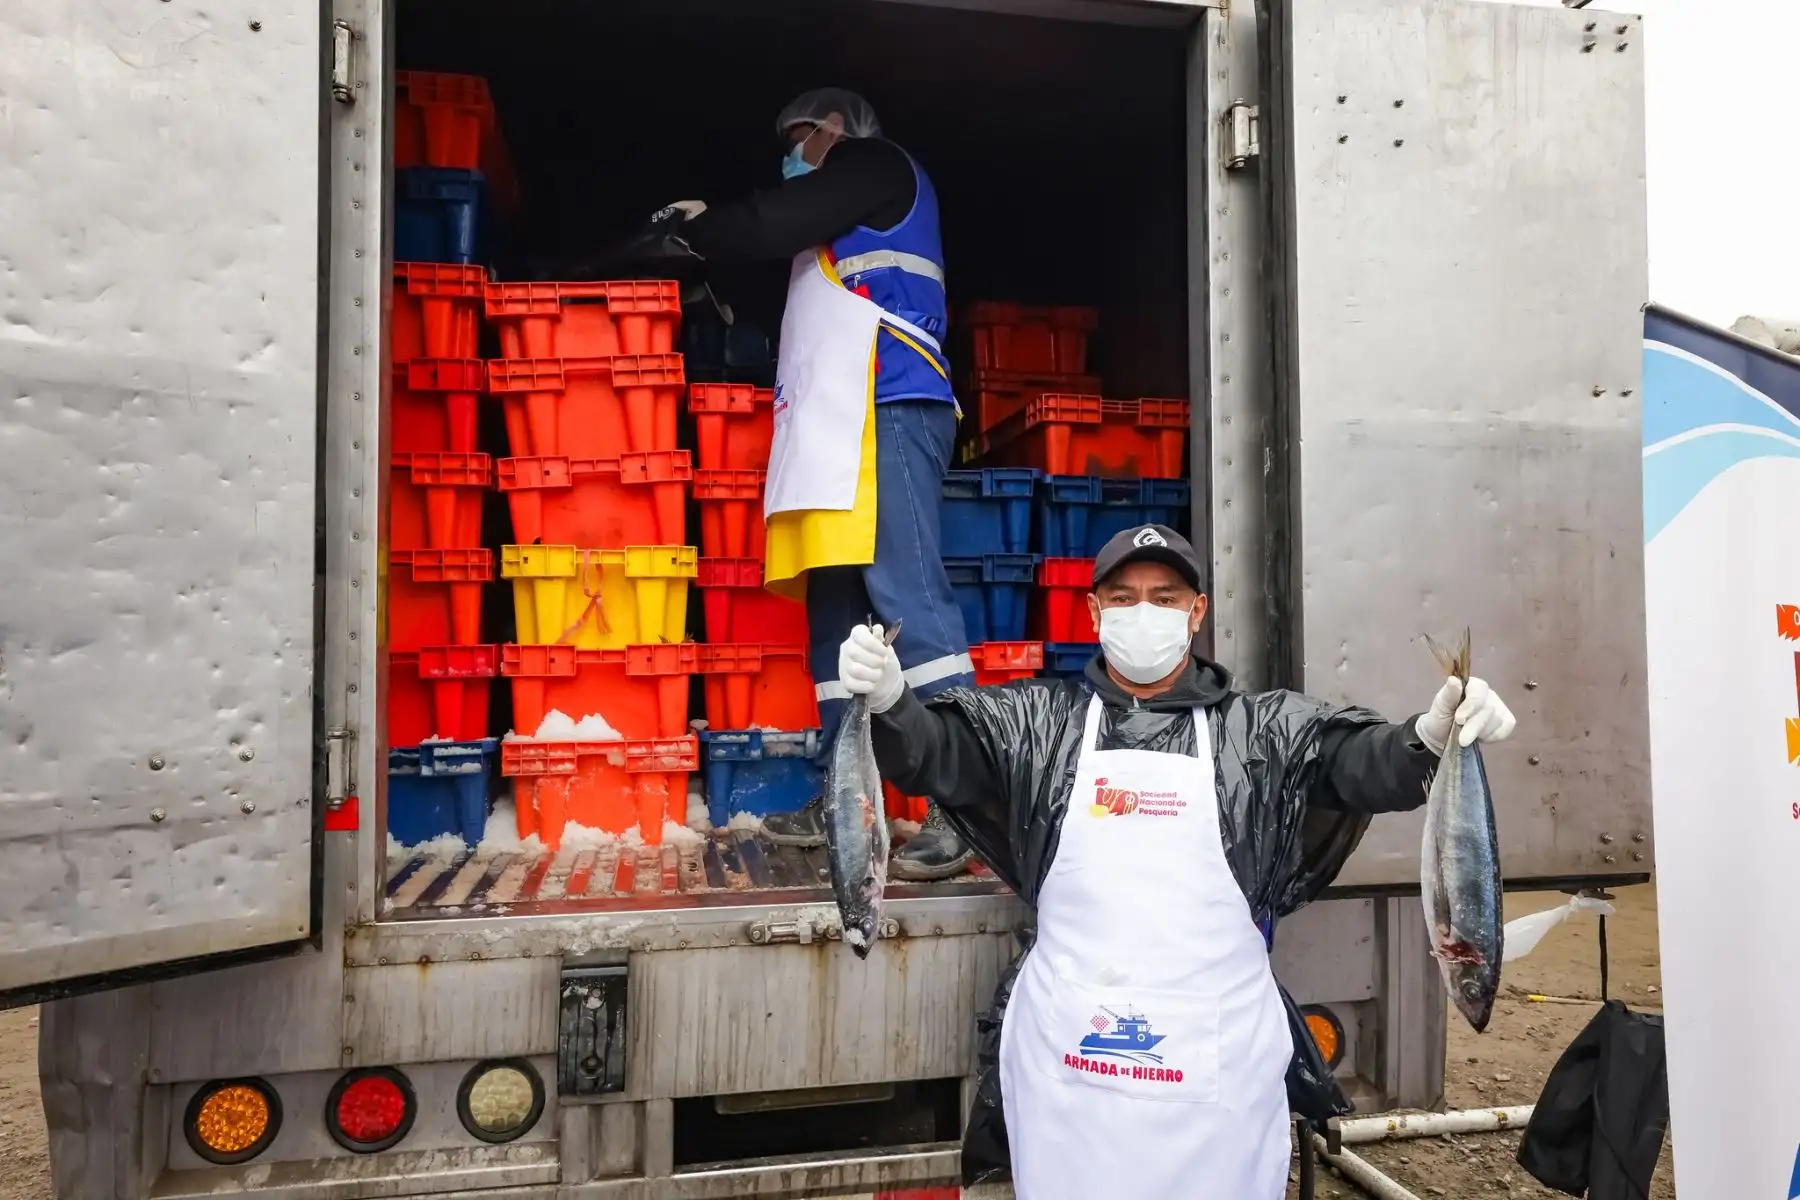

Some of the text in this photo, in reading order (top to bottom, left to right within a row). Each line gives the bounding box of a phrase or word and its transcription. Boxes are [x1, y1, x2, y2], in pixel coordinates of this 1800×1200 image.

[1139, 790, 1177, 799] Sociedad
[1139, 799, 1175, 807] Nacional
[1064, 1053, 1184, 1083] ARMADA DE HIERRO
